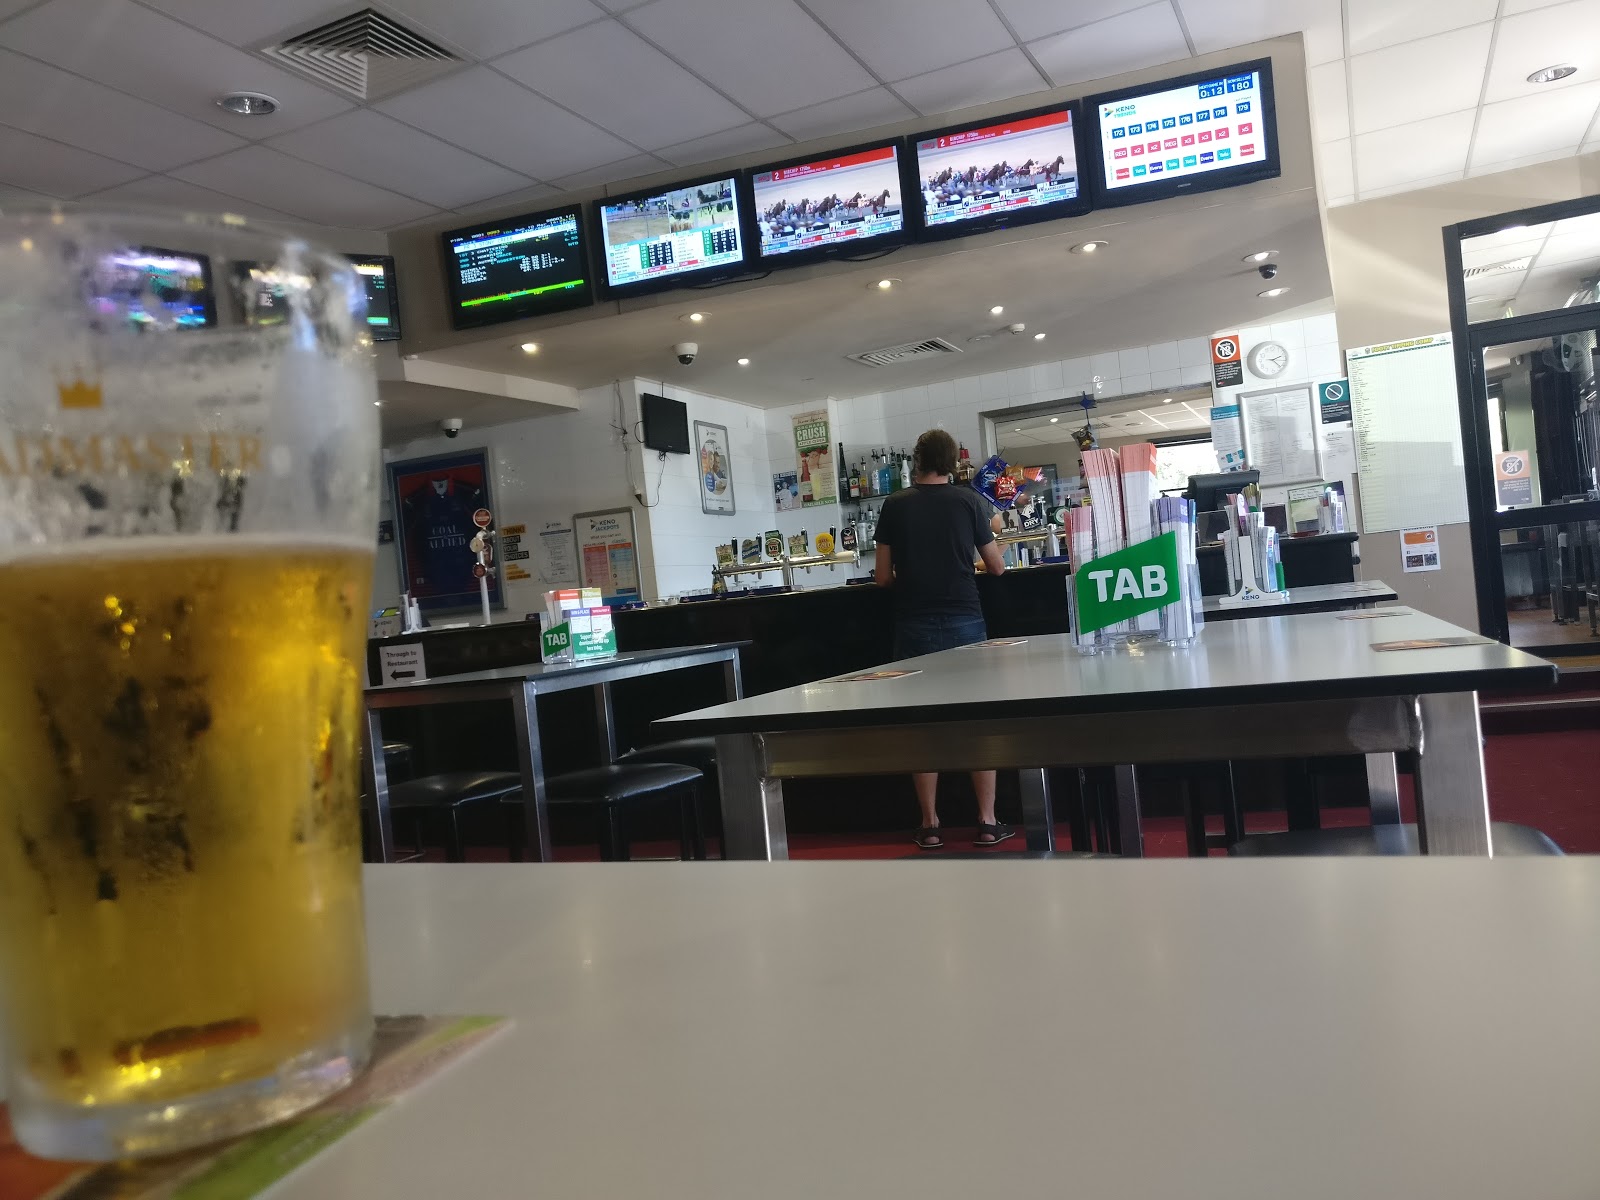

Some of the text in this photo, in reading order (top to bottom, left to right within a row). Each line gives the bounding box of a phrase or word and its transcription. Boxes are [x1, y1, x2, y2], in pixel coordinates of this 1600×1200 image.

[1232, 80, 1250, 91] 180
[1200, 86, 1223, 97] 0:12
[1116, 104, 1136, 113] KENO
[1114, 128, 1124, 136] 172
[1130, 125, 1140, 133] 173
[1164, 119, 1174, 127] 175
[940, 138, 946, 147] 2
[1114, 149, 1127, 157] REG
[774, 172, 780, 180] 2
[796, 426, 826, 441] CRUSH
[595, 524, 620, 532] JACKPOTS
[1024, 518, 1039, 528] DRY
[432, 524, 459, 536] COAL
[430, 536, 466, 549] ALLIED
[504, 552, 529, 560] CHOICES
[1088, 564, 1168, 602] TAB
[546, 632, 568, 646] TAB
